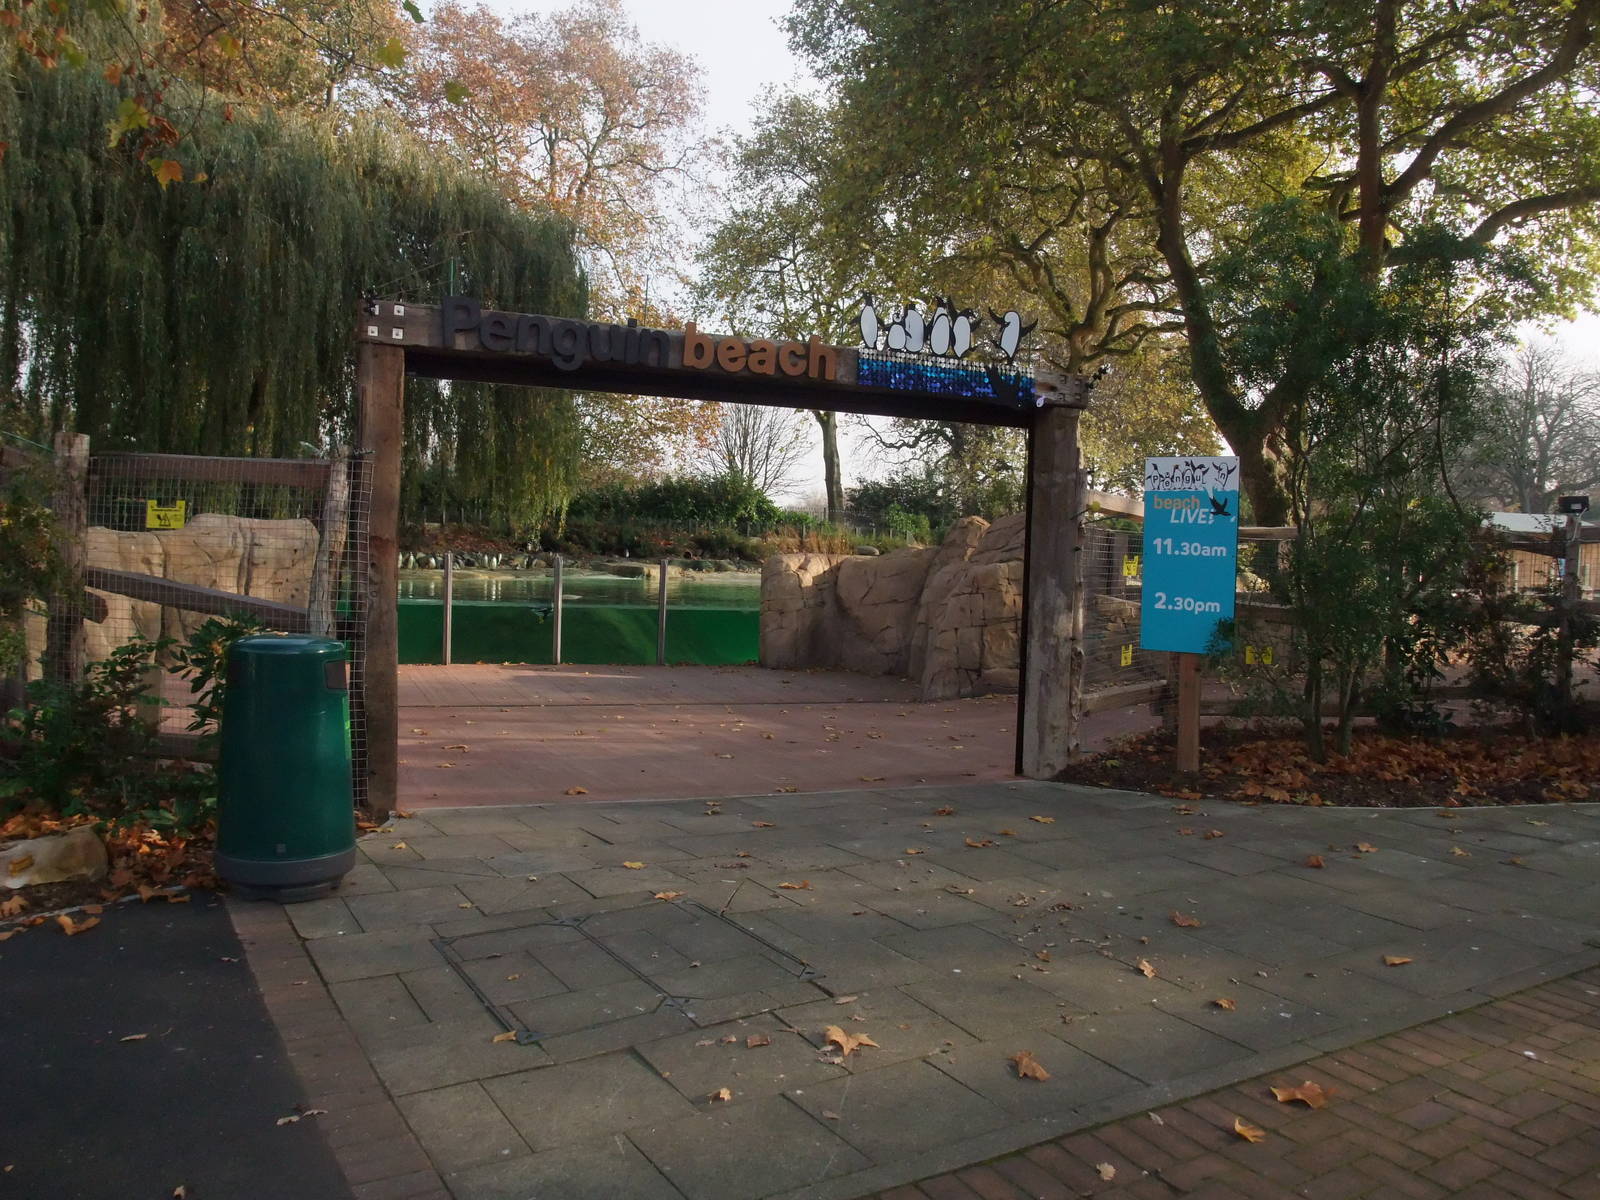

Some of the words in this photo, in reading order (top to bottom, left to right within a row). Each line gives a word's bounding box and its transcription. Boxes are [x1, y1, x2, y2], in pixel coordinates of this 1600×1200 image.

[442, 296, 670, 371] Penguin
[683, 322, 837, 380] beach
[1153, 495, 1201, 511] beach
[1153, 538, 1228, 557] 11.30am
[1154, 592, 1221, 614] 2.30pm
